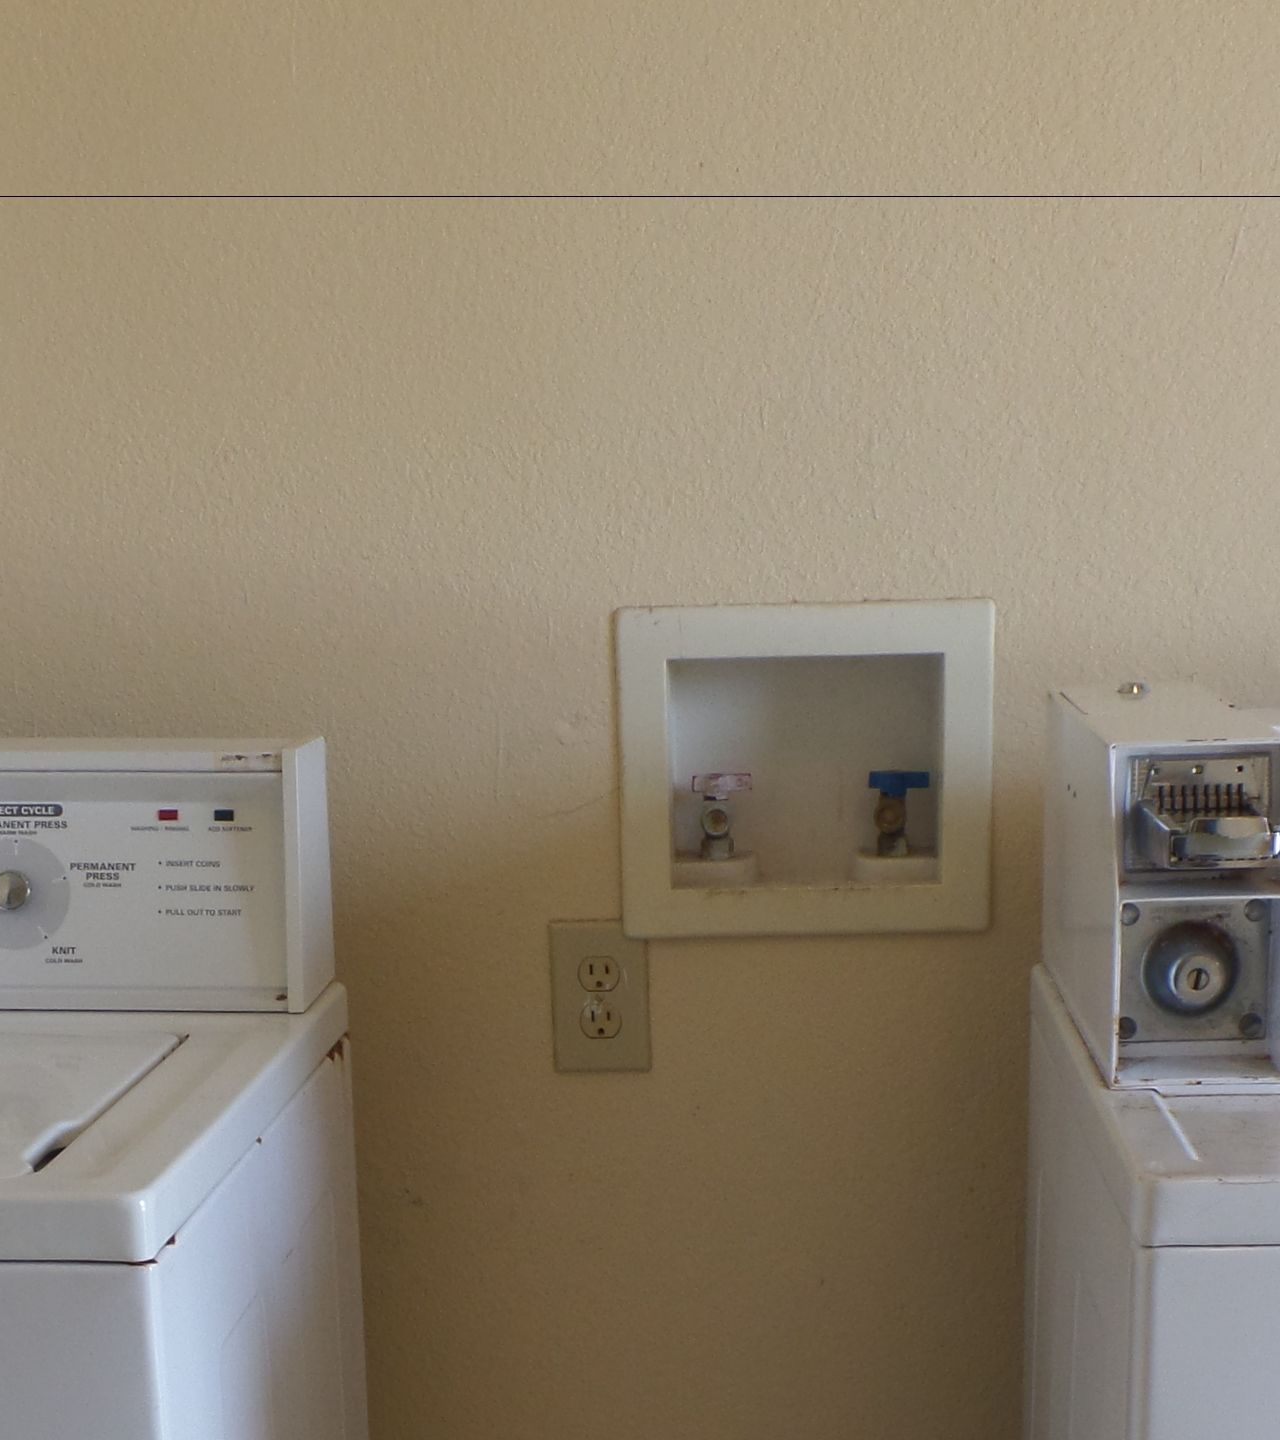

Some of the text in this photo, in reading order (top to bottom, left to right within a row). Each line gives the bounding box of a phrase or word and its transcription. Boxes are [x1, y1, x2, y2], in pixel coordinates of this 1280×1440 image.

[21, 806, 55, 815] CYCLE
[33, 820, 68, 829] PRESS
[70, 862, 137, 871] PERMANENT
[85, 872, 120, 880] PRESS
[51, 946, 77, 955] KNIT
